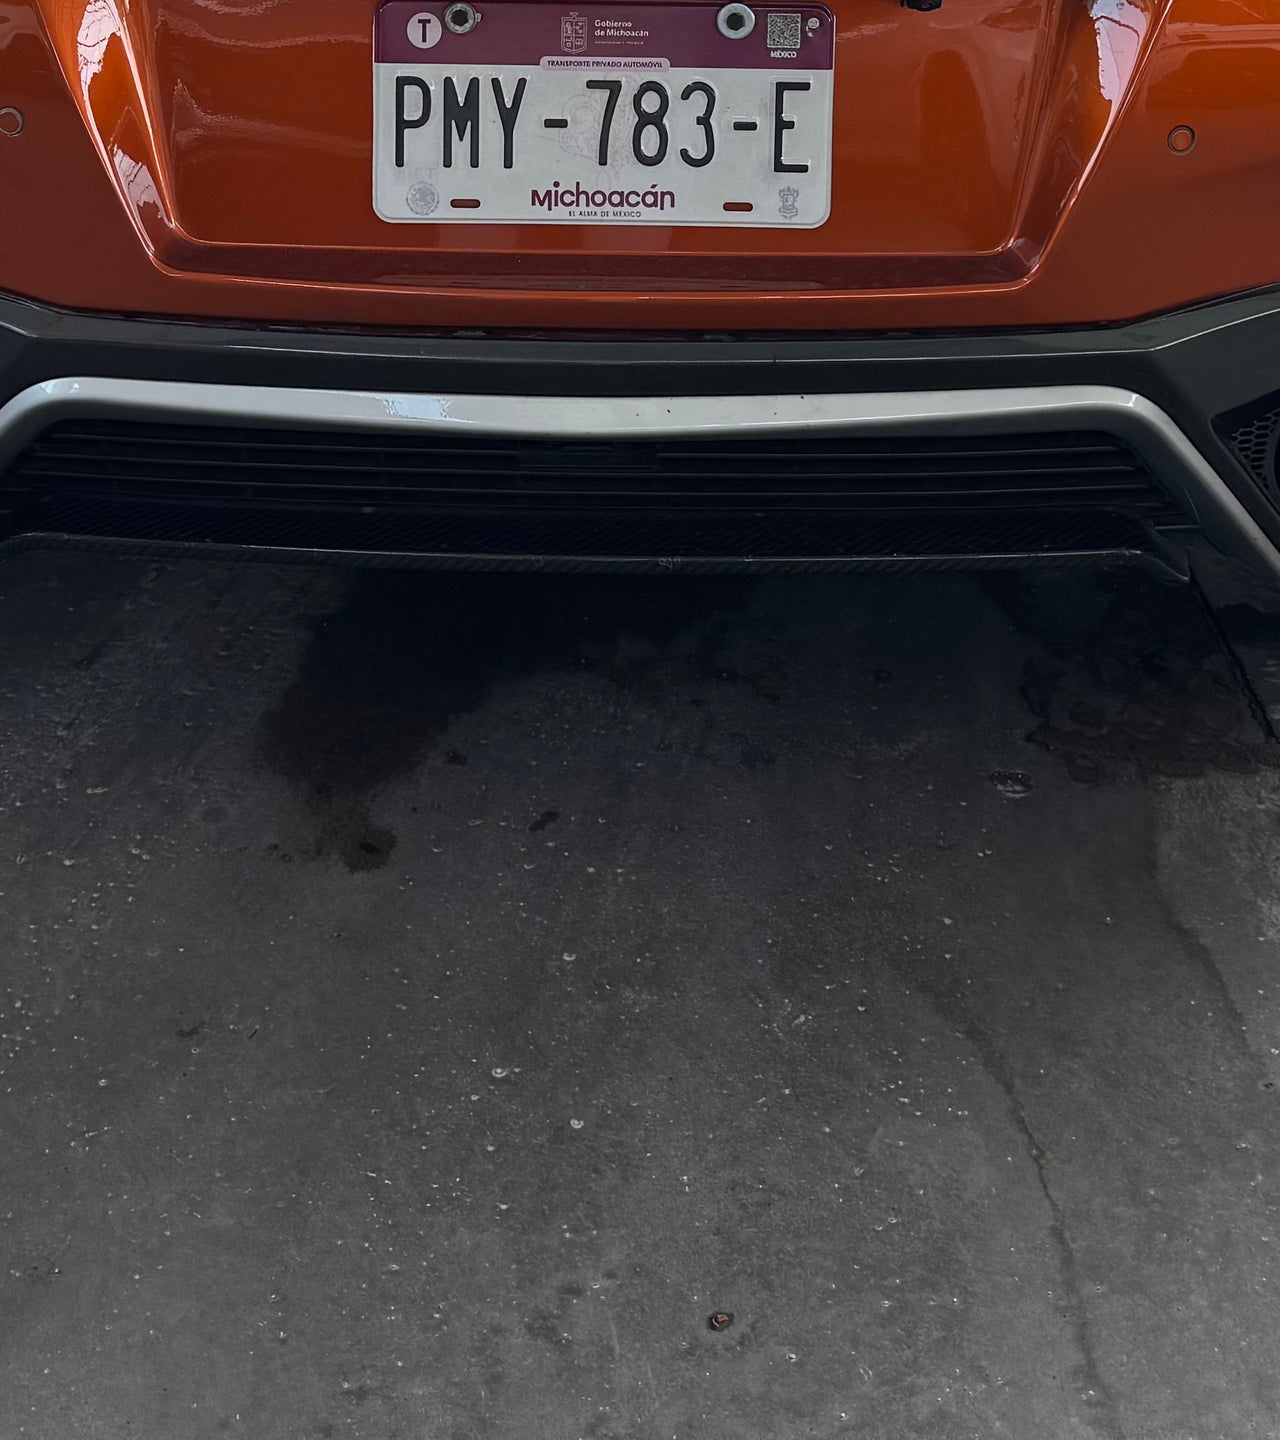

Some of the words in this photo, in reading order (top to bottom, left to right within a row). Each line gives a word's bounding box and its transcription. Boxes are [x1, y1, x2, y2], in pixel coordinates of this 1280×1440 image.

[417, 18, 431, 43] T
[594, 19, 632, 28] Gobierno
[594, 29, 605, 37] de
[547, 60, 590, 68] TRANSPORTE
[591, 60, 622, 68] PRIVADO
[395, 75, 811, 173] PMY-783-E
[531, 180, 676, 211] Michoacán
